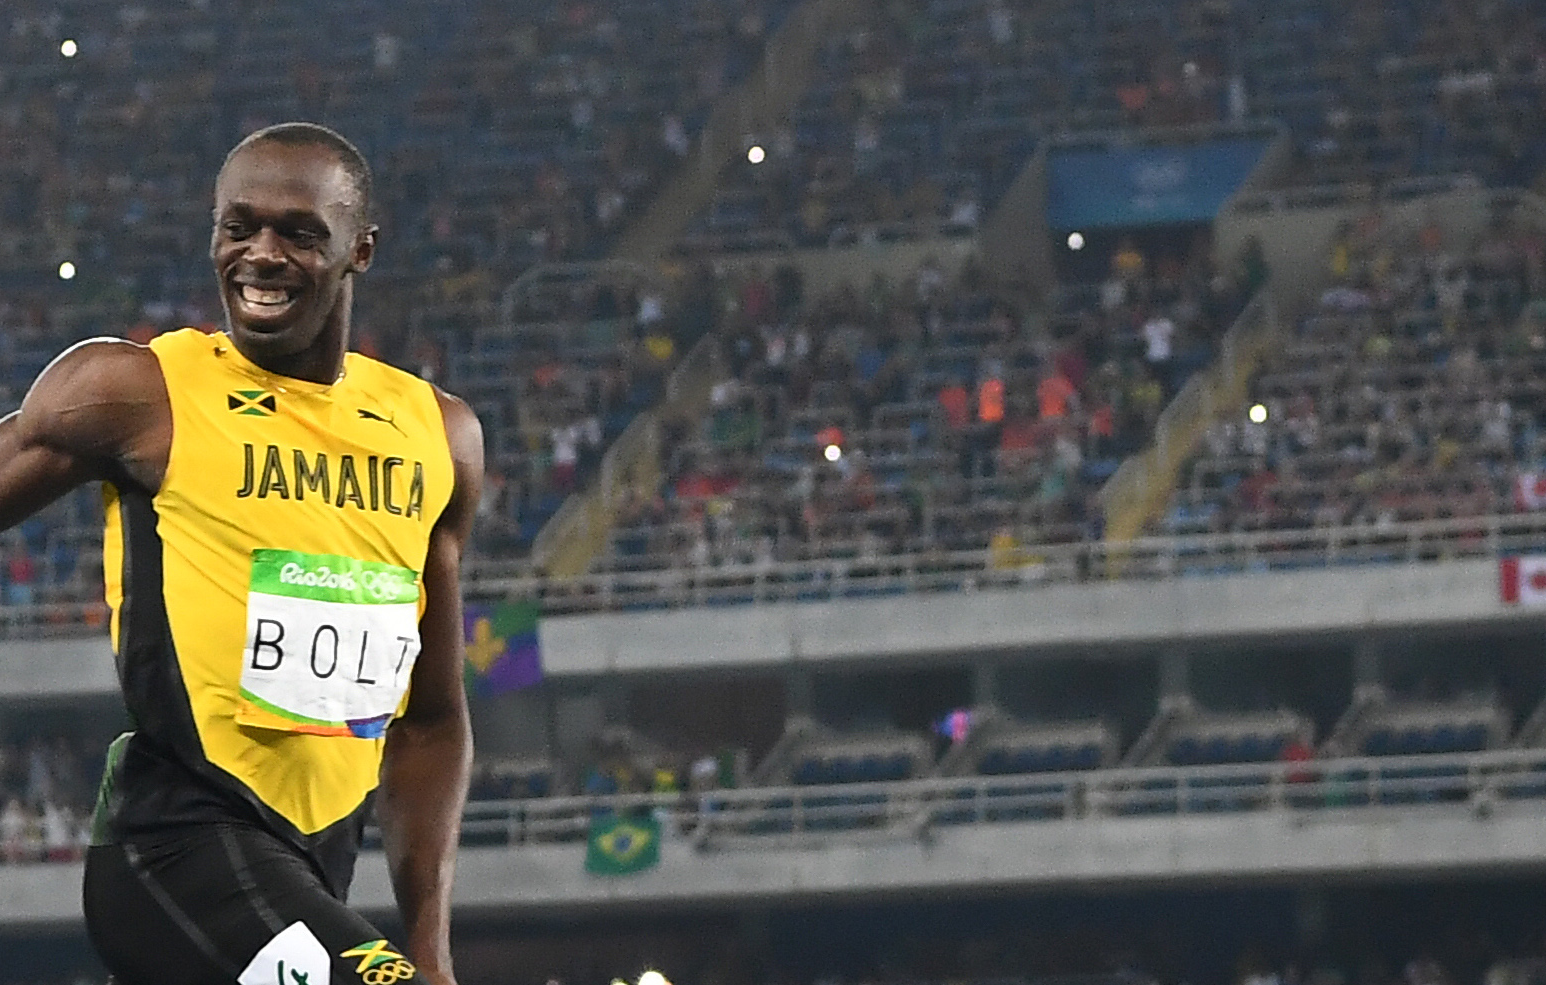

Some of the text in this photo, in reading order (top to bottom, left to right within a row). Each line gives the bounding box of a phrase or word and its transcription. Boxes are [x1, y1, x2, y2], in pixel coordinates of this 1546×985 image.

[236, 443, 425, 522] JAMAICA
[279, 562, 356, 591] Rio2016
[250, 618, 415, 688] BOLT
